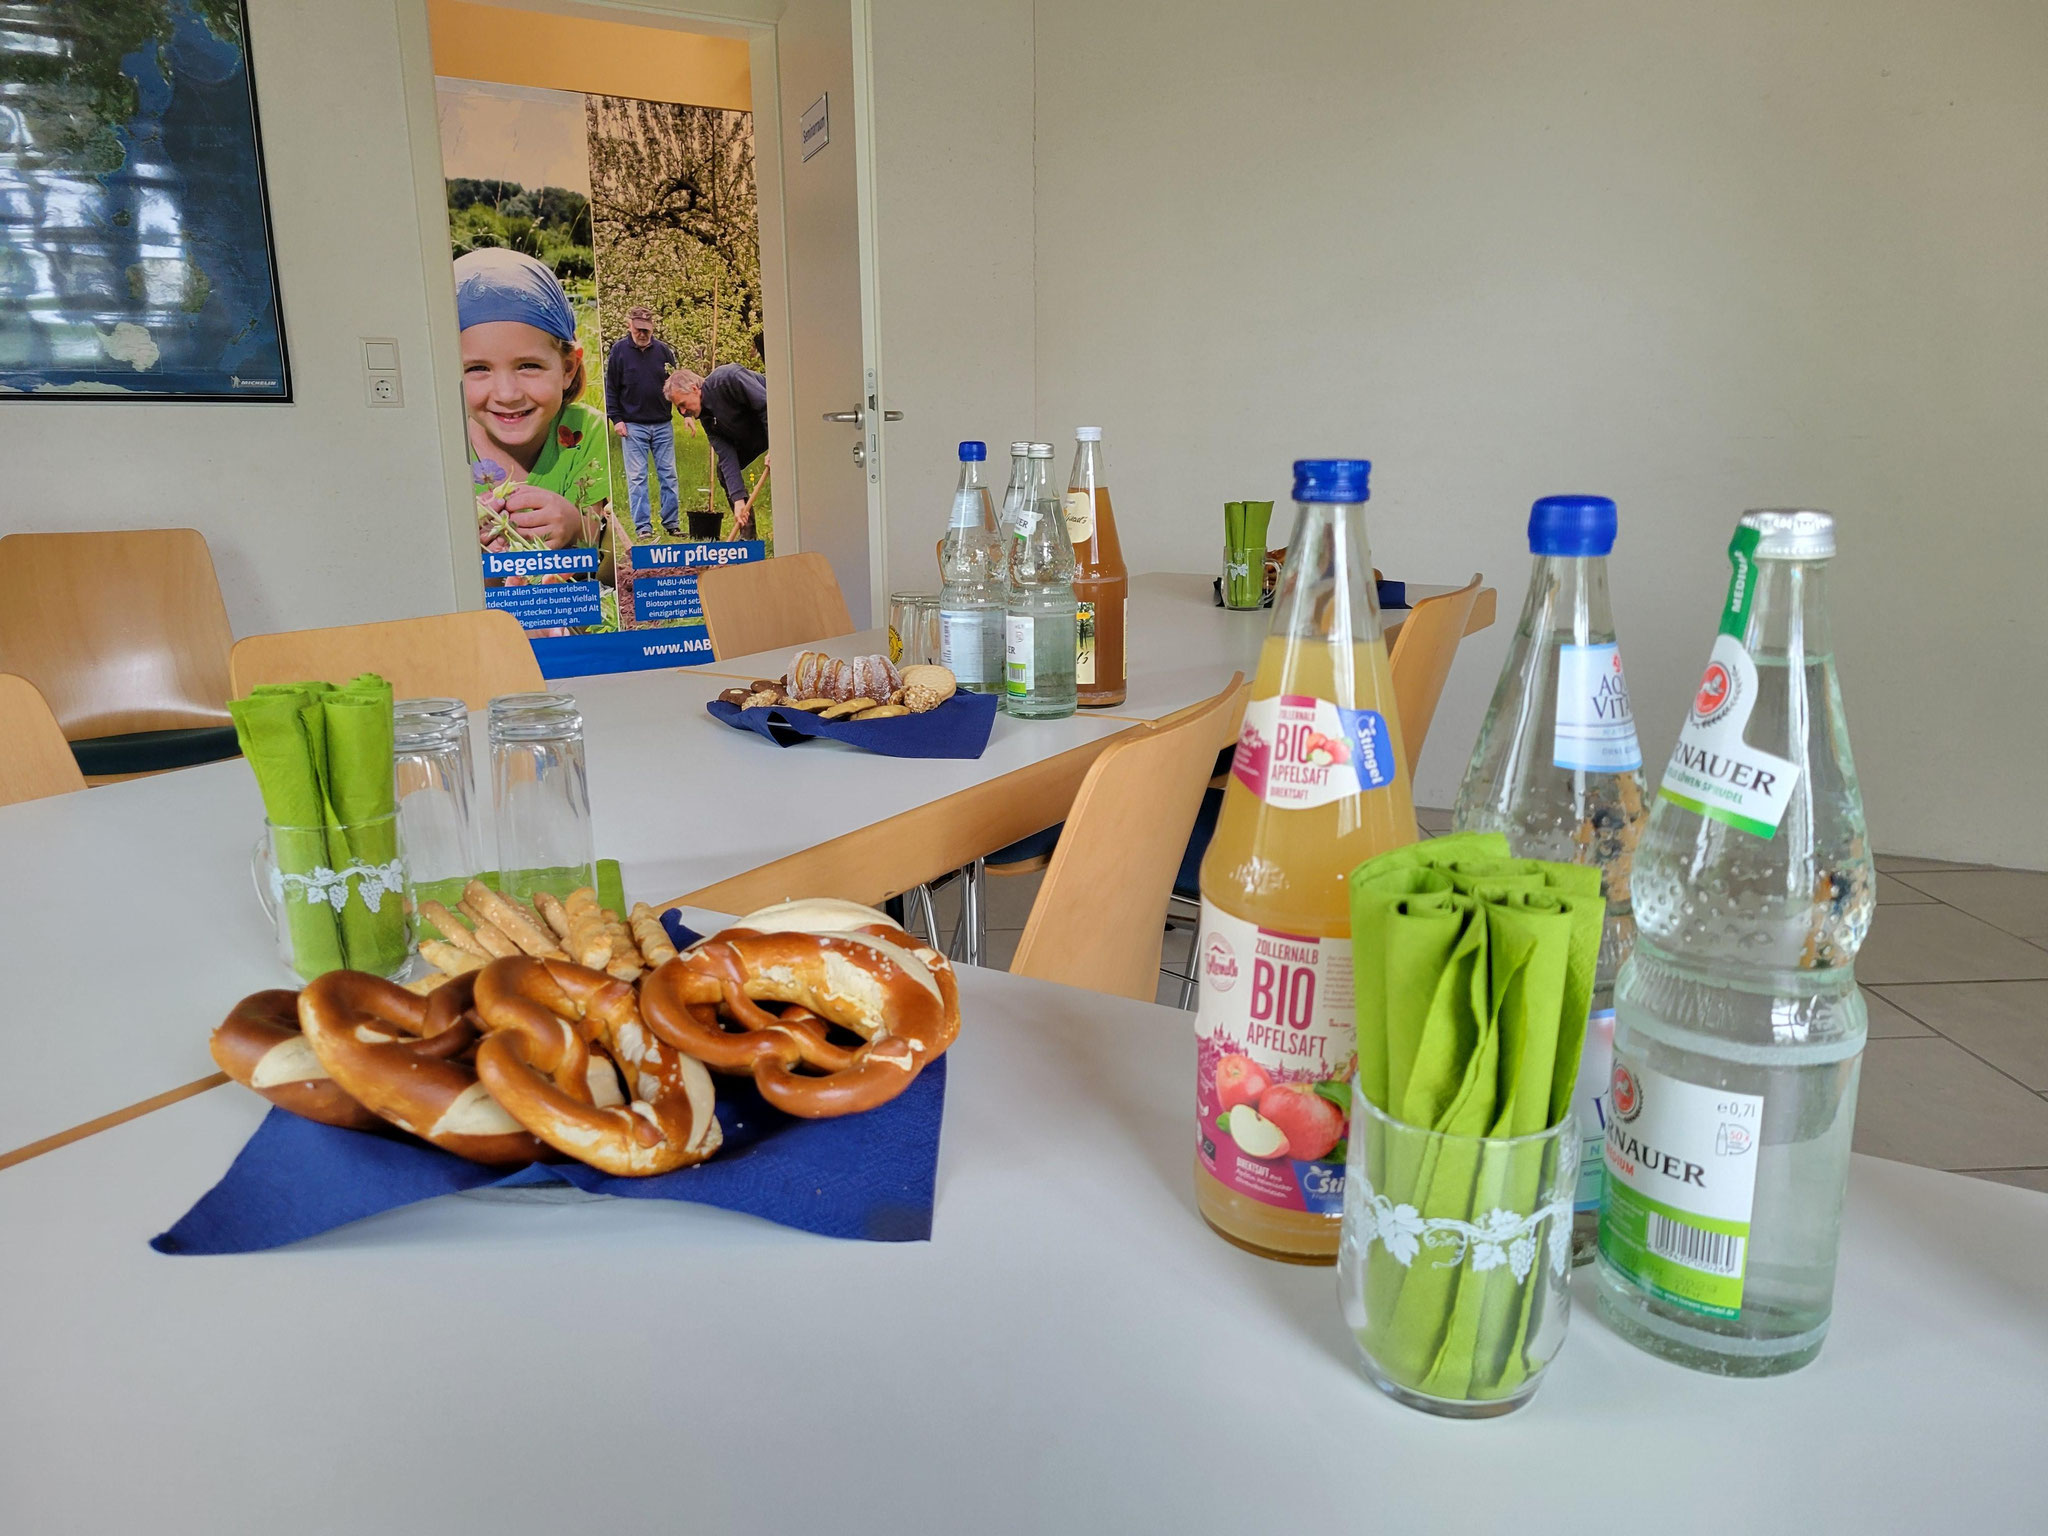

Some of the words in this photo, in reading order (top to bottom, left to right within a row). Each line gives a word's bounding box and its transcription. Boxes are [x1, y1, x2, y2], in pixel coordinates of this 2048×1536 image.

[490, 553, 593, 576] begeistern
[650, 546, 680, 564] Wir
[685, 545, 748, 566] pflegen
[498, 589, 510, 597] mit
[512, 588, 531, 596] allen
[532, 587, 558, 595] Sinnen
[559, 585, 590, 593] erleben,
[1731, 550, 1748, 613] MEDIUM
[520, 598, 534, 606] und
[536, 597, 548, 605] die
[549, 596, 571, 604] bunte
[572, 594, 597, 603] Vielfalt
[645, 599, 672, 608] Biotope
[674, 598, 687, 606] und
[648, 589, 677, 597] erhalten
[524, 608, 552, 617] stecken
[554, 607, 572, 616] Jung
[574, 605, 588, 613] und
[588, 604, 599, 612] Alt
[649, 608, 688, 618] einzigartige
[642, 639, 713, 656] www.NAB
[1275, 723, 1313, 764] BIO
[1358, 729, 1384, 784] Stingel
[1271, 764, 1329, 786] APFELSAFT
[1255, 938, 1319, 965] ZOLLERNALB
[1250, 957, 1316, 1030] BIO
[1246, 1021, 1328, 1058] APFELSAFT
